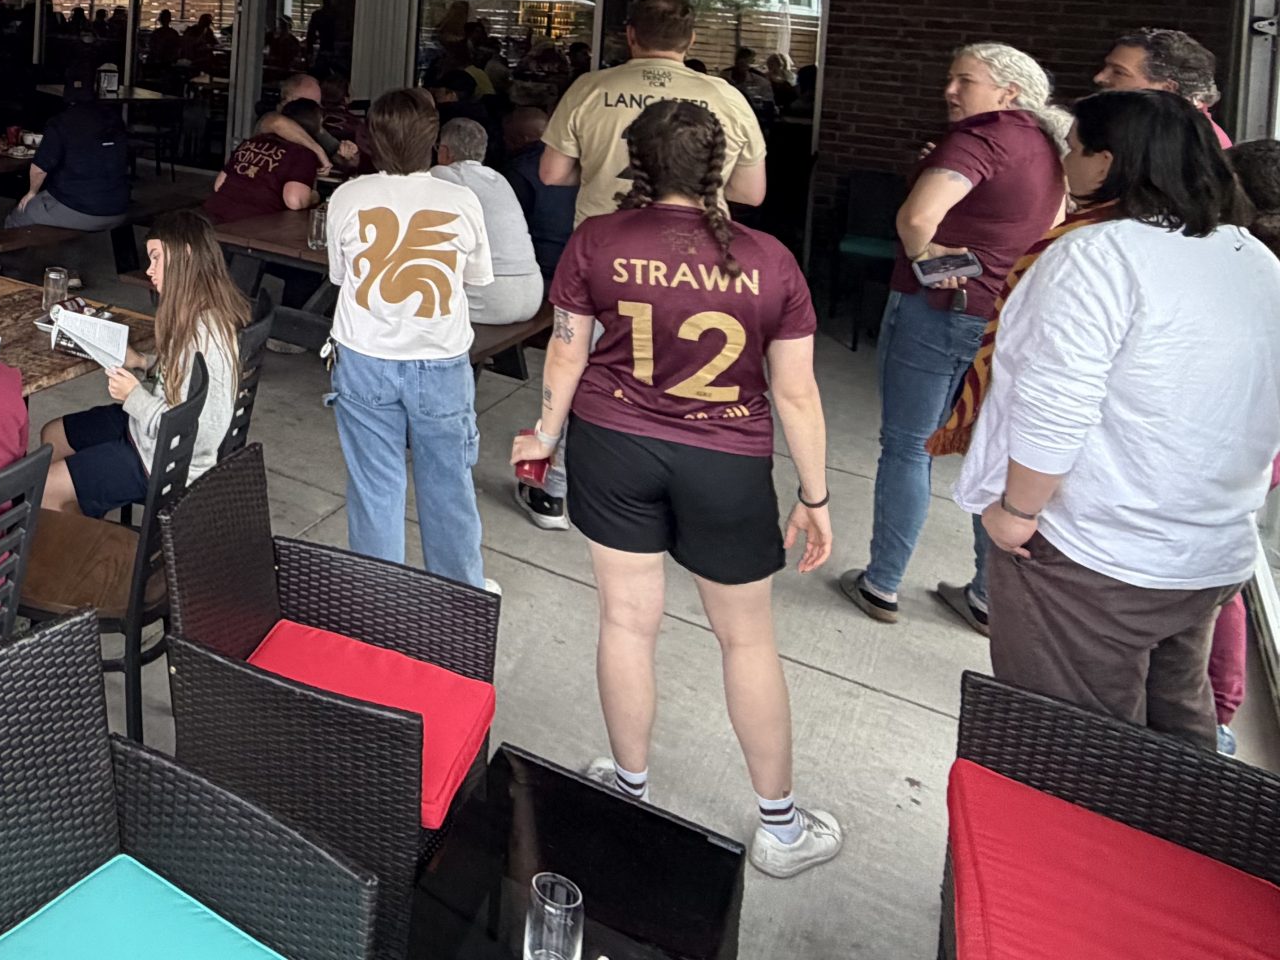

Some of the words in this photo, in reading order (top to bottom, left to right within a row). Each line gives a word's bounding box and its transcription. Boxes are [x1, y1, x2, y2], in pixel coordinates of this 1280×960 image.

[604, 91, 709, 110] LANCR
[234, 150, 279, 172] RINITY
[612, 257, 760, 296] STRAWN
[617, 300, 747, 403] 12
